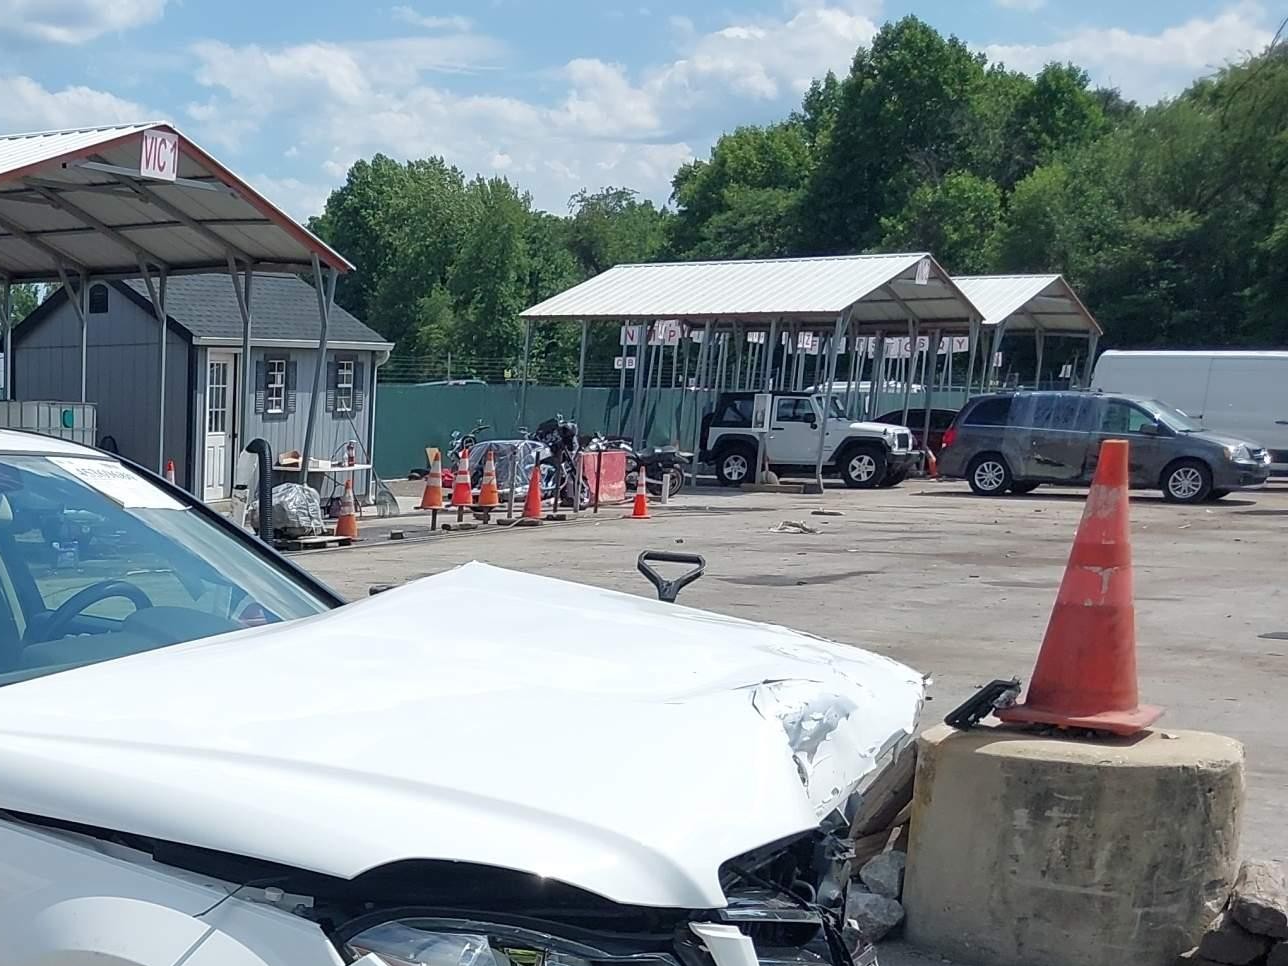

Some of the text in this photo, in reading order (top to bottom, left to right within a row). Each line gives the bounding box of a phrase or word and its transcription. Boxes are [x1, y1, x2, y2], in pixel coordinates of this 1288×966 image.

[144, 135, 177, 174] VIC 1
[626, 329, 635, 342] N
[668, 330, 676, 342] P
[956, 338, 965, 349] Y
